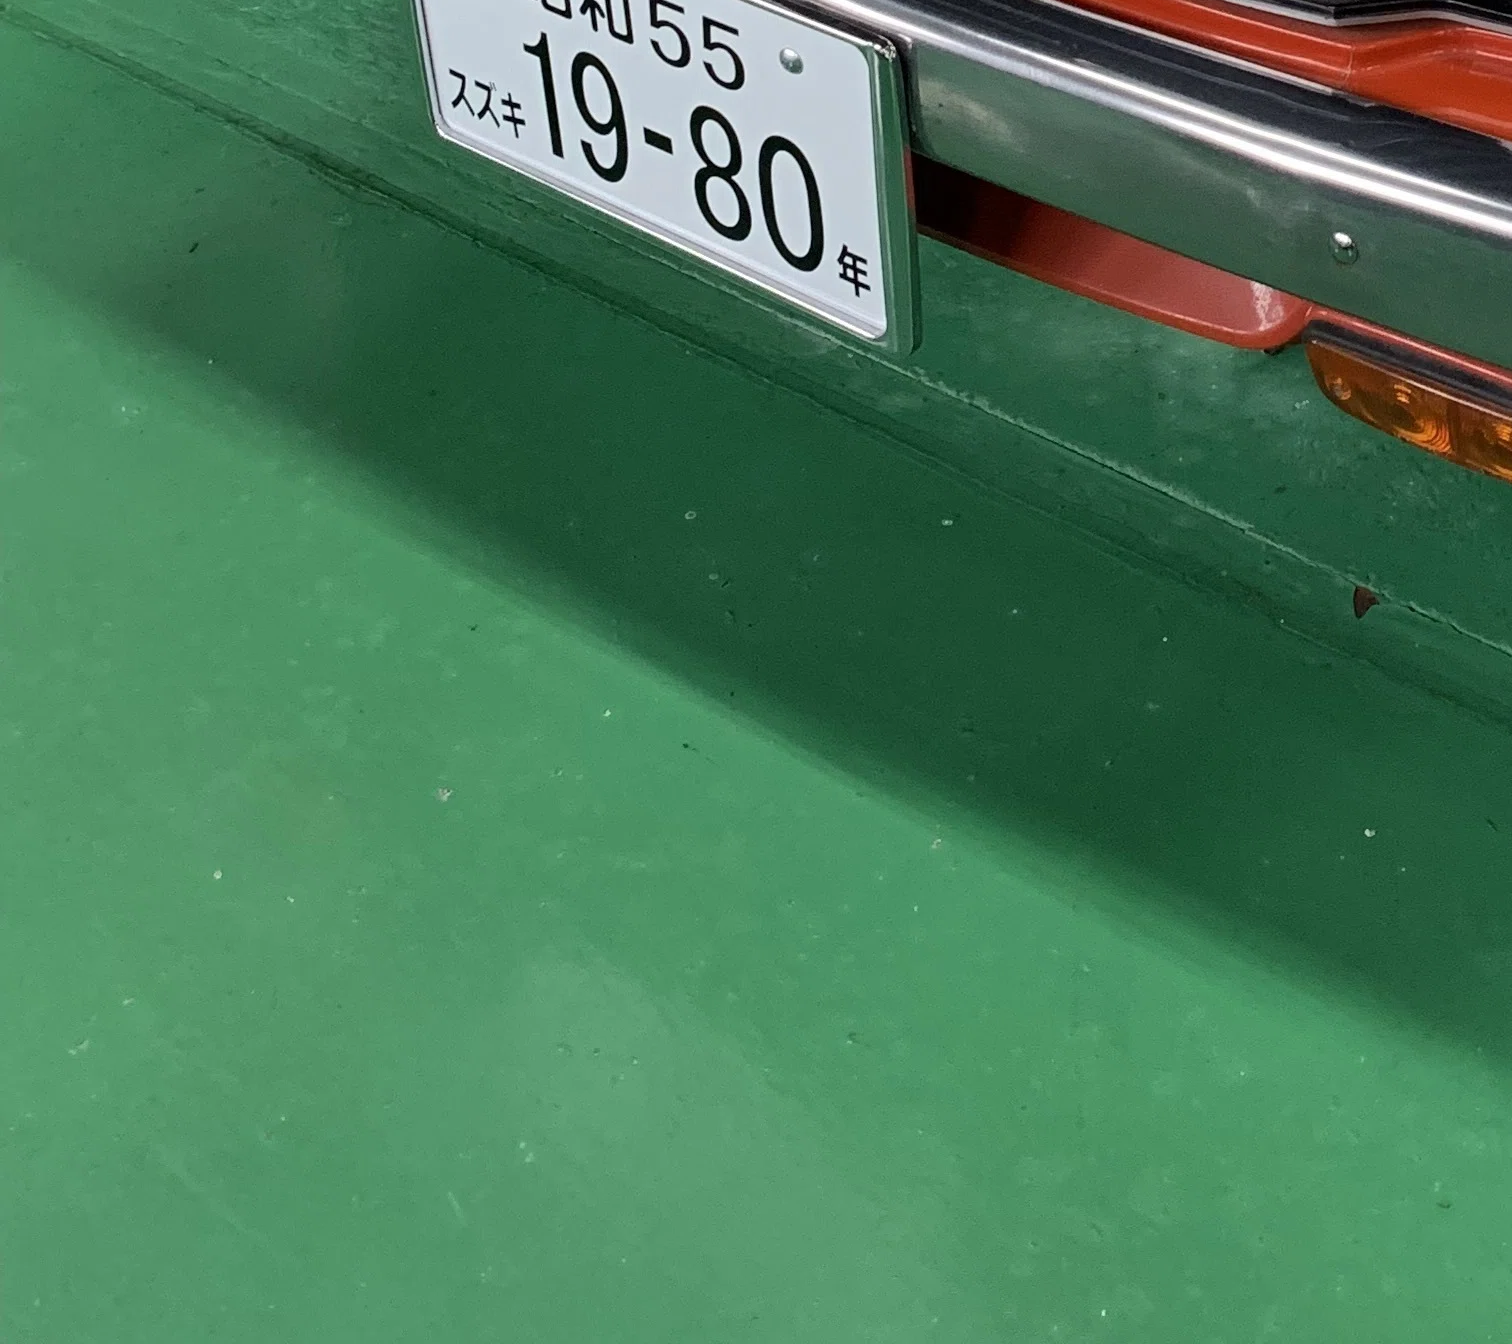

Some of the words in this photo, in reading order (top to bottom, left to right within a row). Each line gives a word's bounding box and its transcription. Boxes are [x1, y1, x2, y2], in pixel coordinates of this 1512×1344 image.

[448, 69, 526, 138] スズキ
[523, 32, 825, 273] 19-80
[836, 245, 871, 297] 年
